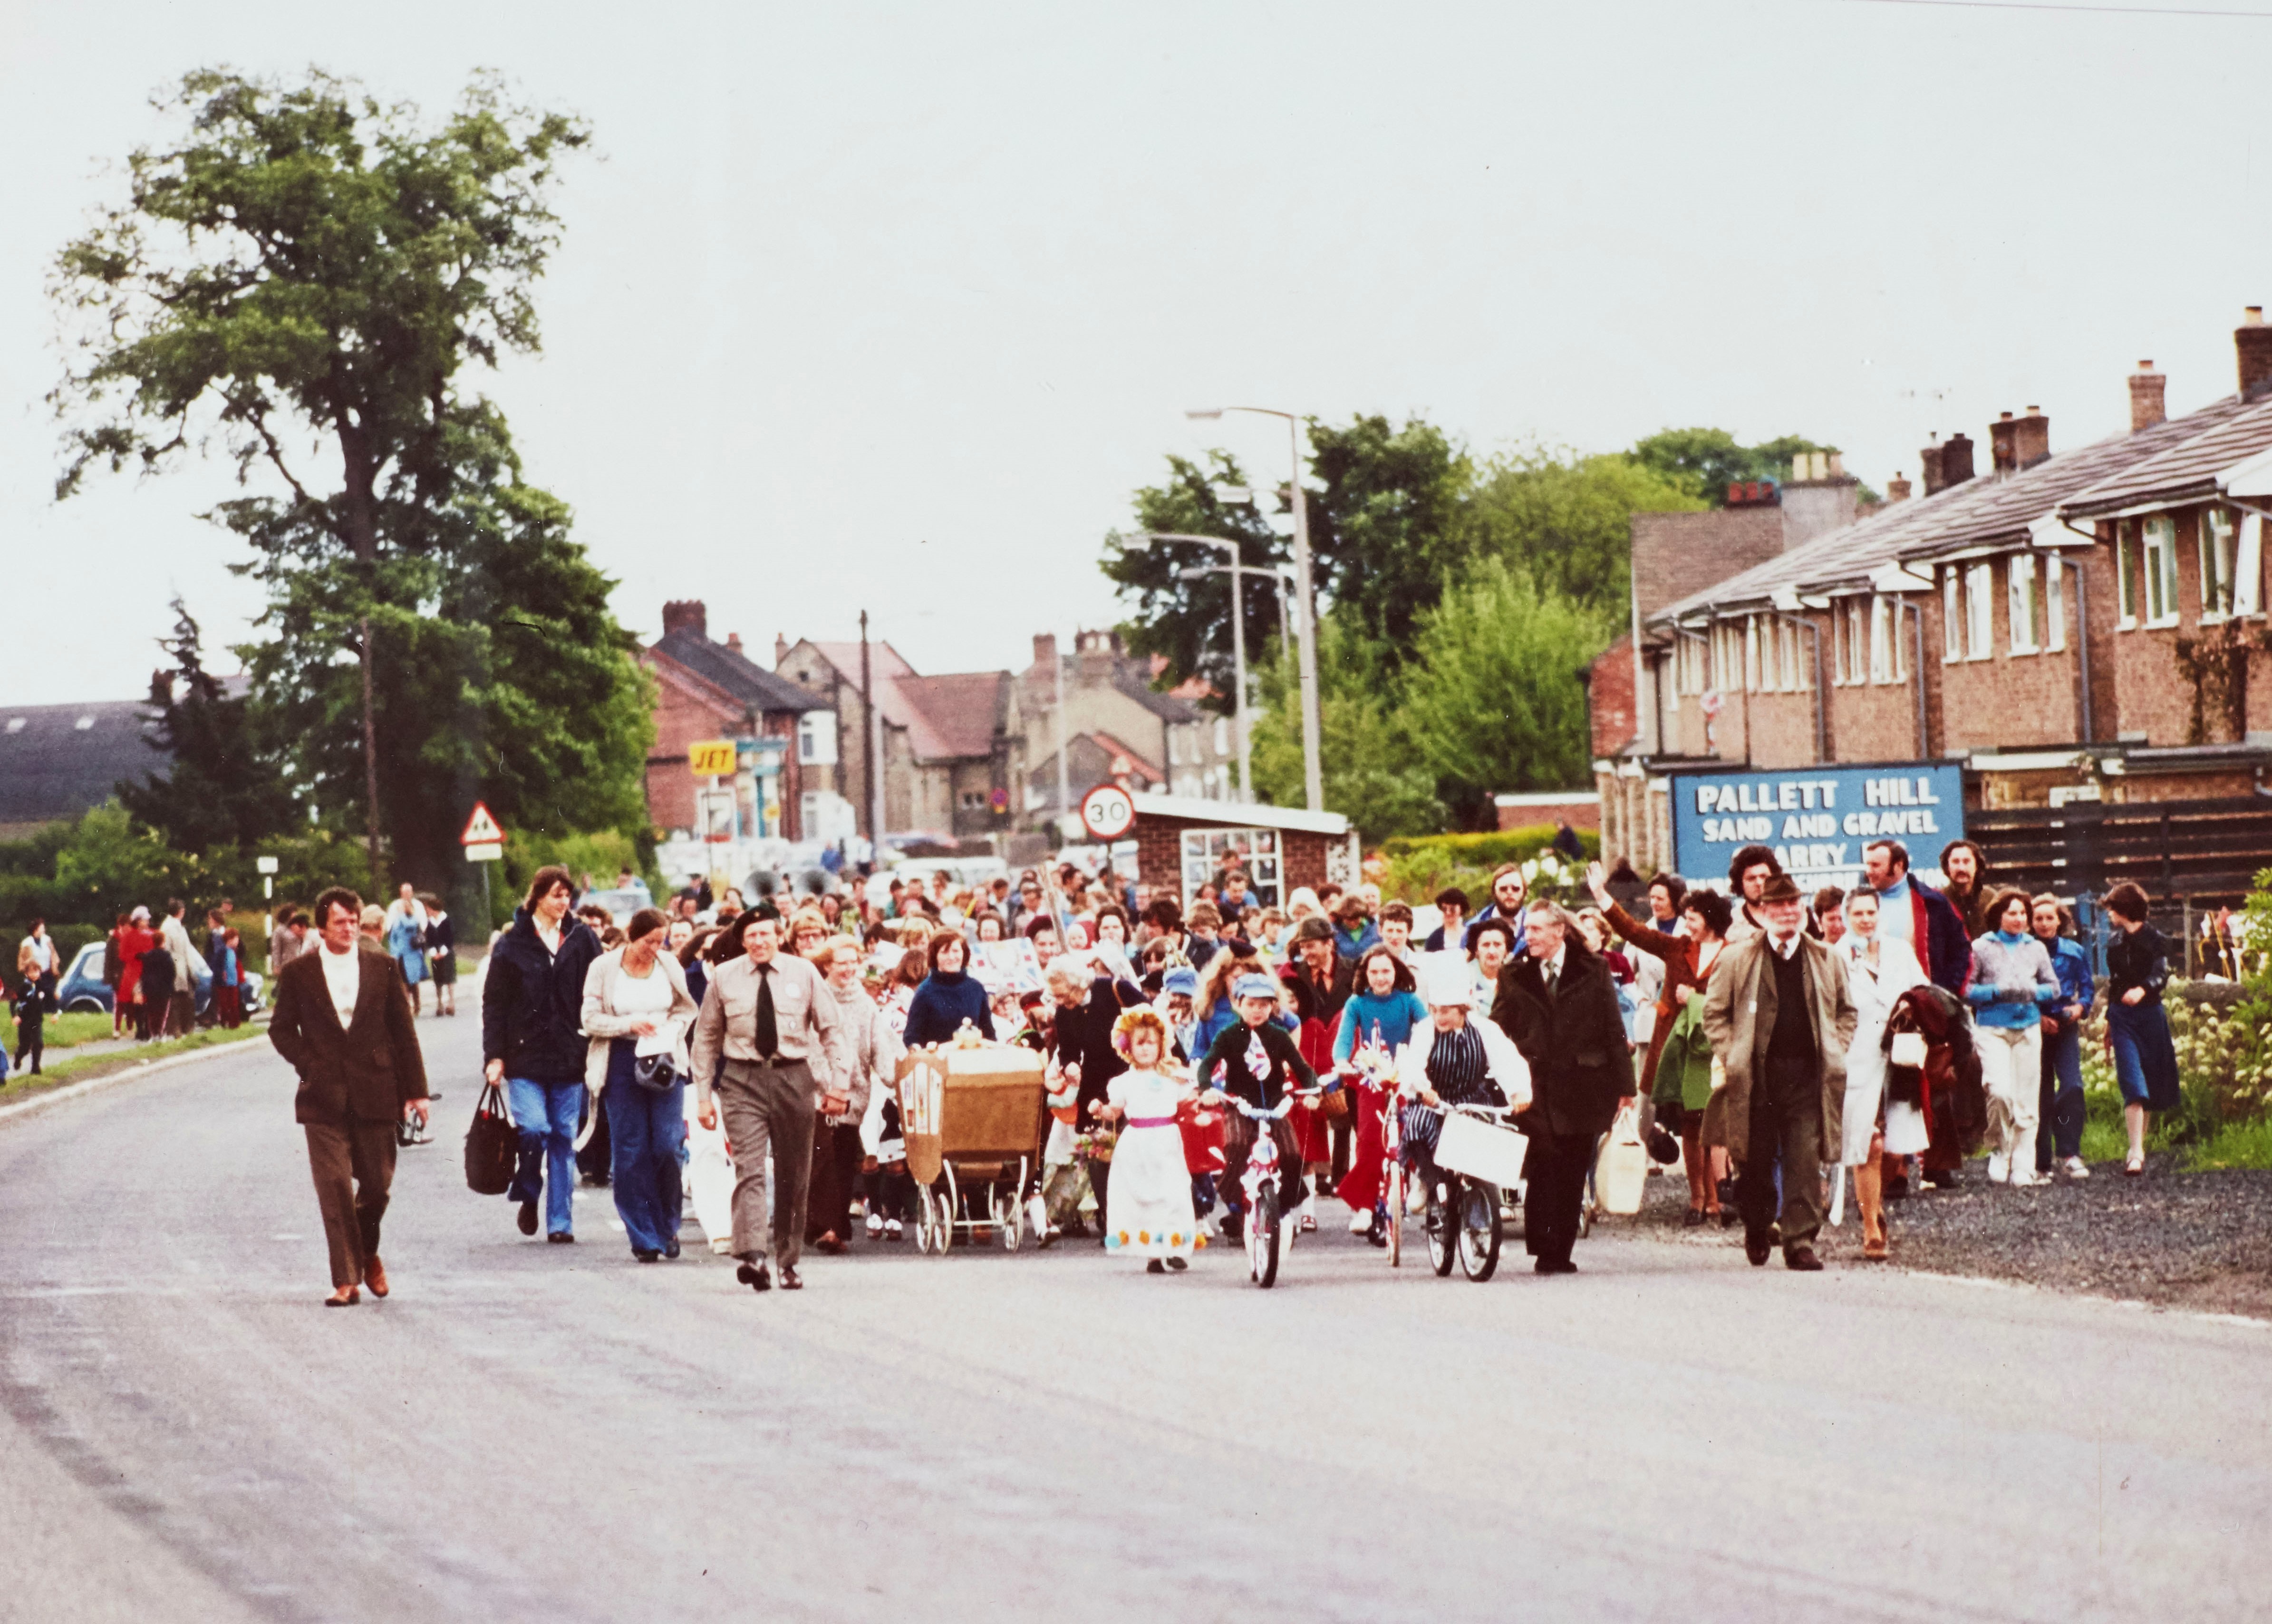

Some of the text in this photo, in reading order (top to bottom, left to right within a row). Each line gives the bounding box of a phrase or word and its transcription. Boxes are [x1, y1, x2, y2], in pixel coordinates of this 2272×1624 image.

[696, 748, 730, 769] JET
[1697, 776, 1940, 814] PALLETT HILL
[1091, 801, 1125, 823] 30
[1702, 809, 1940, 842] SAND AND GRAVEL
